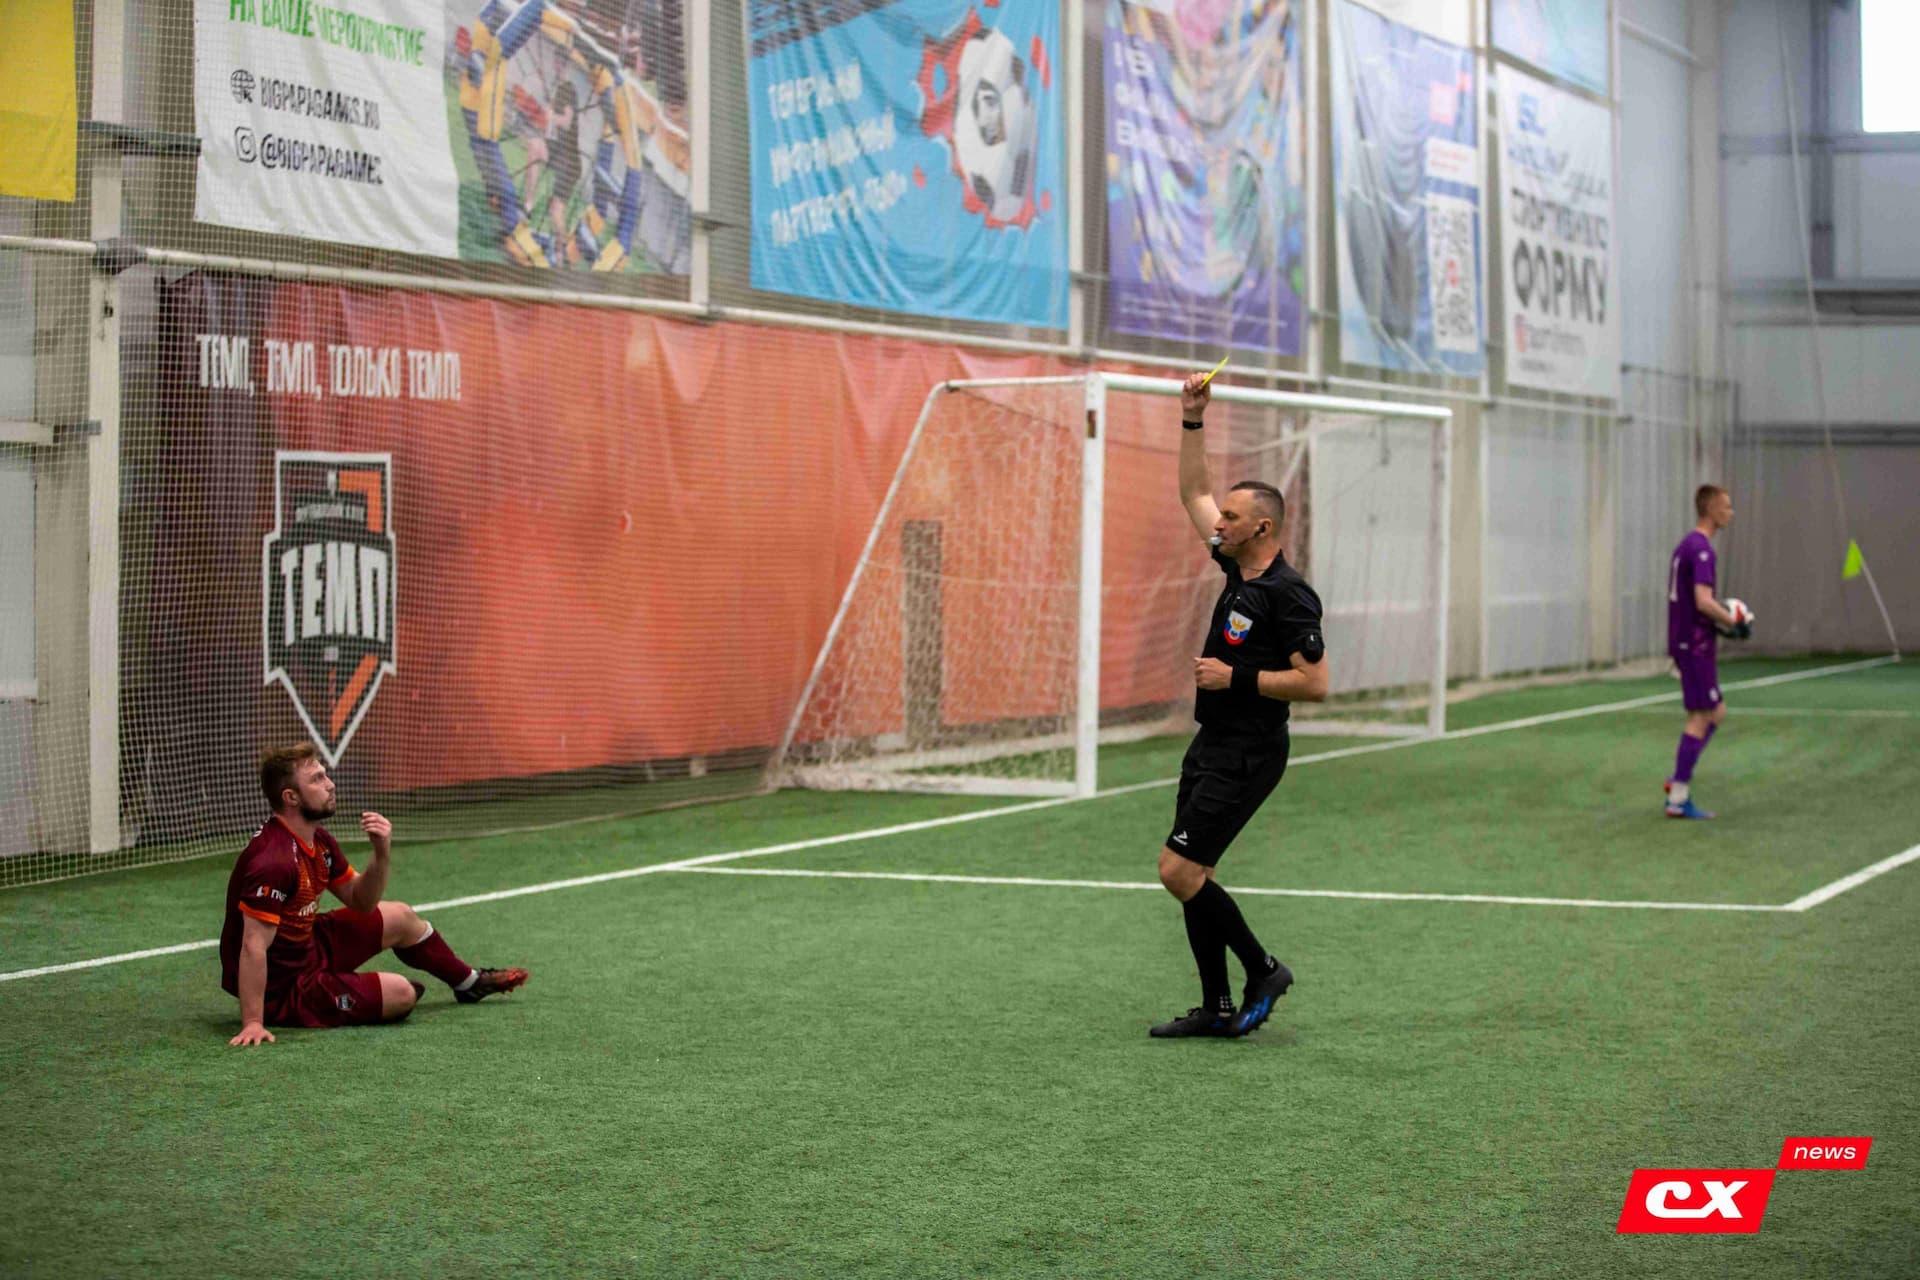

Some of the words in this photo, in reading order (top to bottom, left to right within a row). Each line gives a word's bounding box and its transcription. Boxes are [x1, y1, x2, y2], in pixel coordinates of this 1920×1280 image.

[195, 334, 255, 397] ТЕМП,
[264, 339, 323, 400] ТЕМП,
[280, 541, 388, 647] ТЕМП
